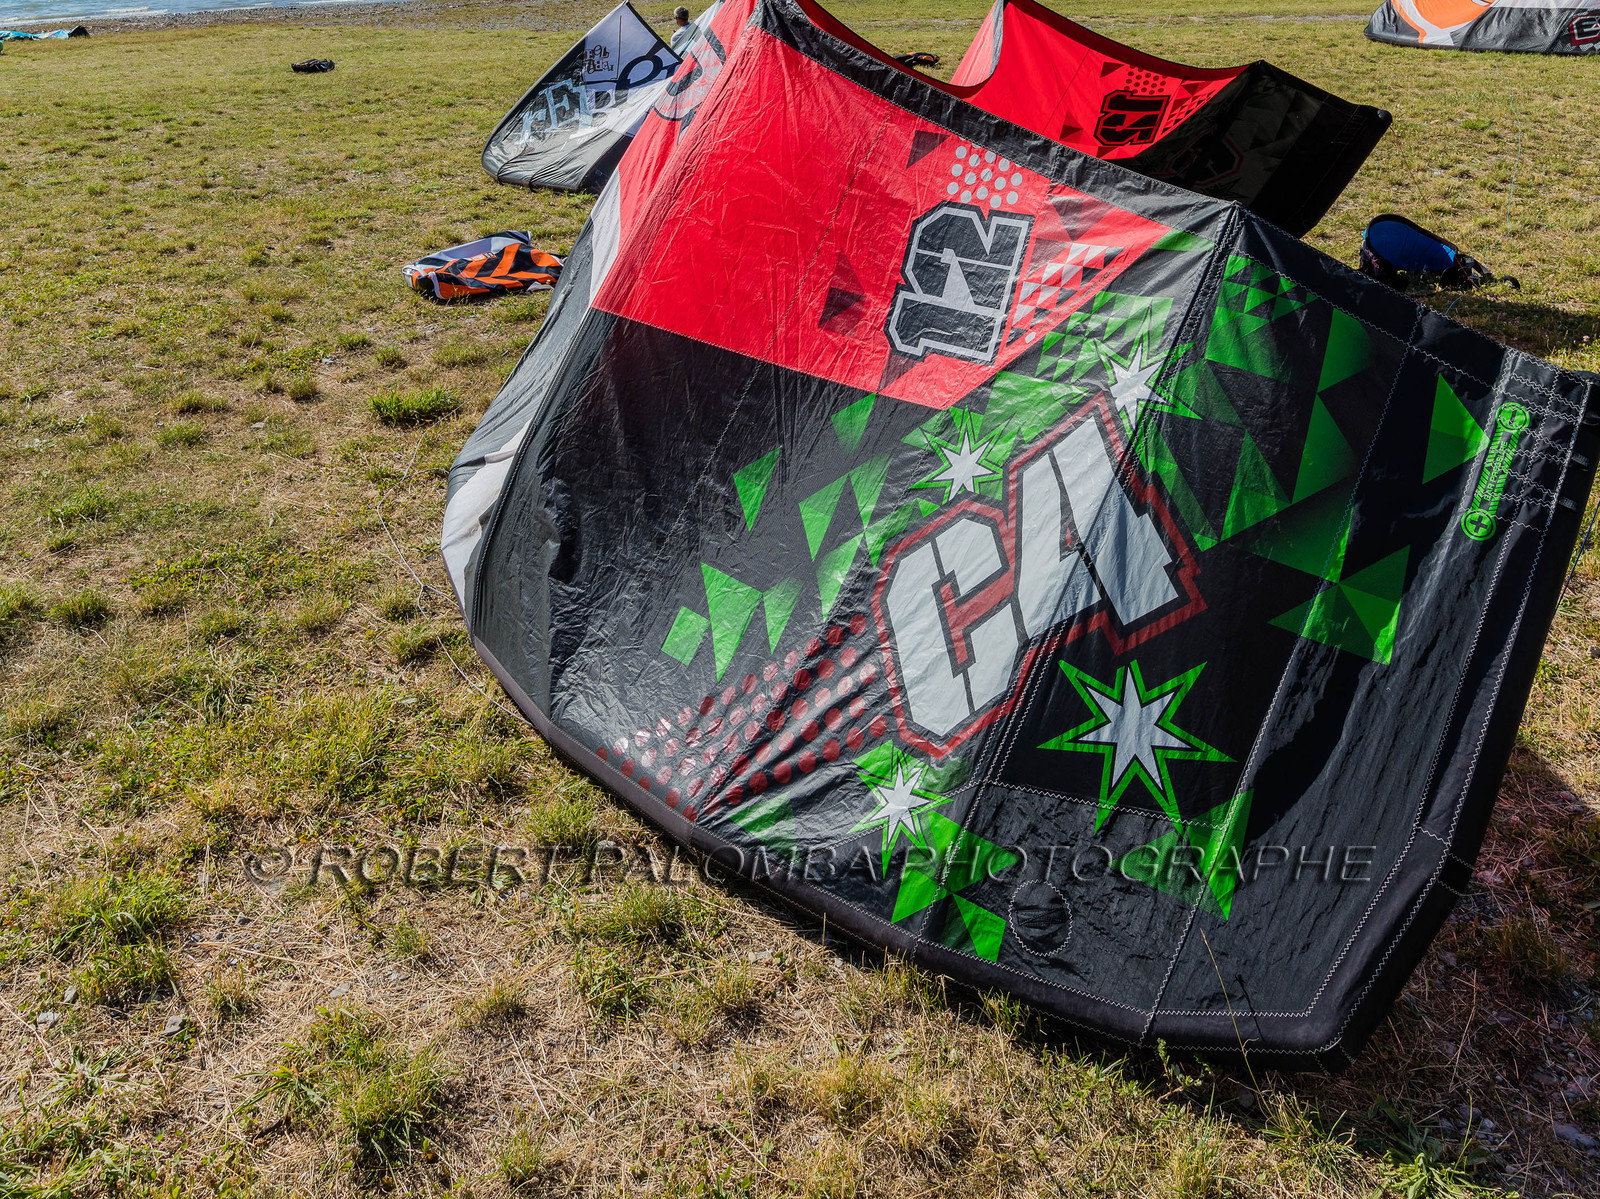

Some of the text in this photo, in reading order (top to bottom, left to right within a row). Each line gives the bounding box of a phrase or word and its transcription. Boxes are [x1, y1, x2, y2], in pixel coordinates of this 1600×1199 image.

[884, 201, 1036, 367] 12
[1484, 441, 1508, 501] BAR PRESSURE
